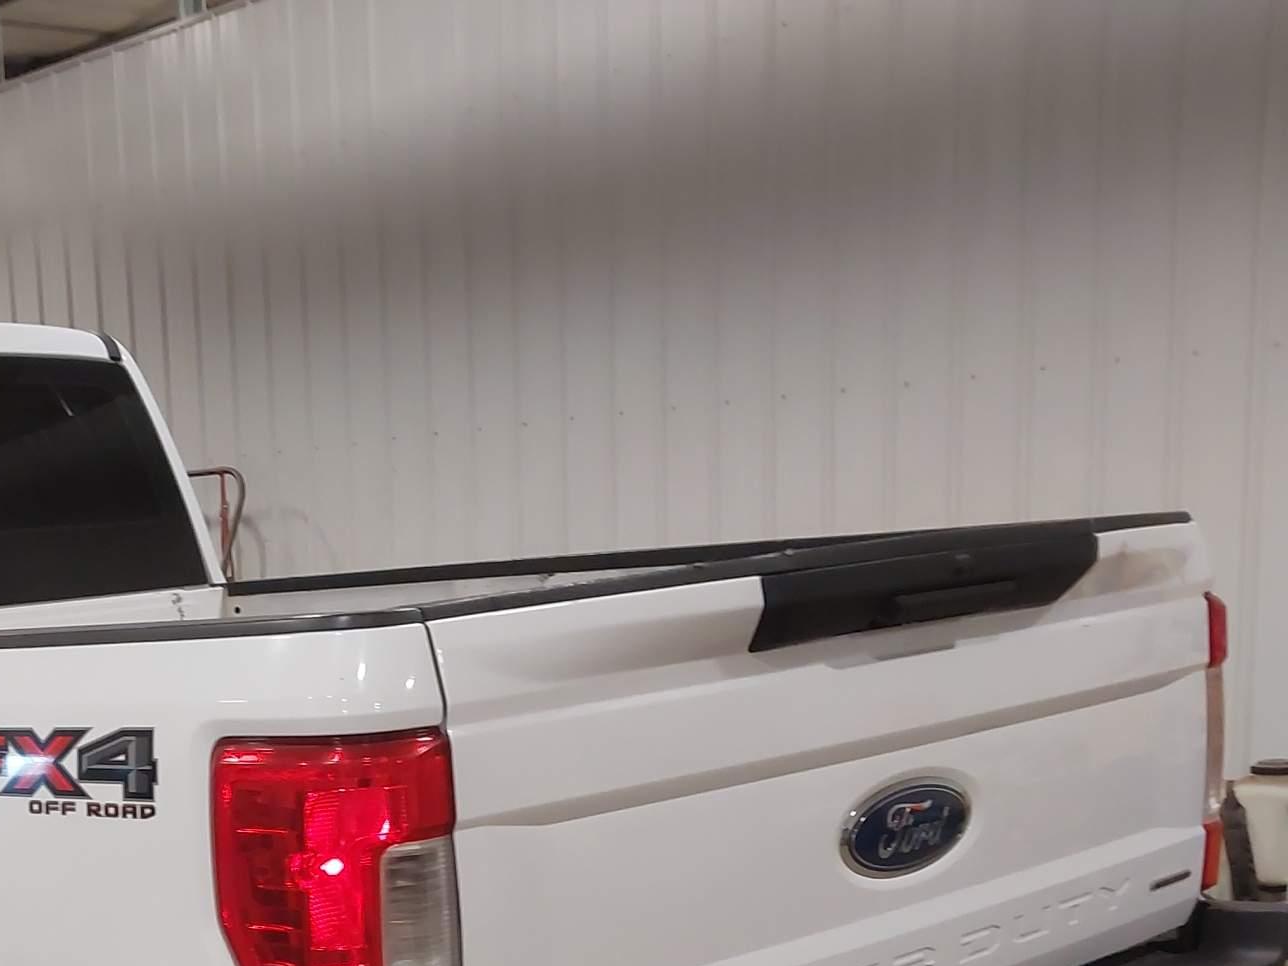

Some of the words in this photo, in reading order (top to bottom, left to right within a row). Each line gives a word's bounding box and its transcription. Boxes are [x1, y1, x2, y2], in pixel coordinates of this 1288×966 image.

[28, 800, 76, 815] OFF
[86, 802, 156, 819] ROAD
[878, 800, 950, 858] Ford
[959, 878, 1131, 964] DUTY
